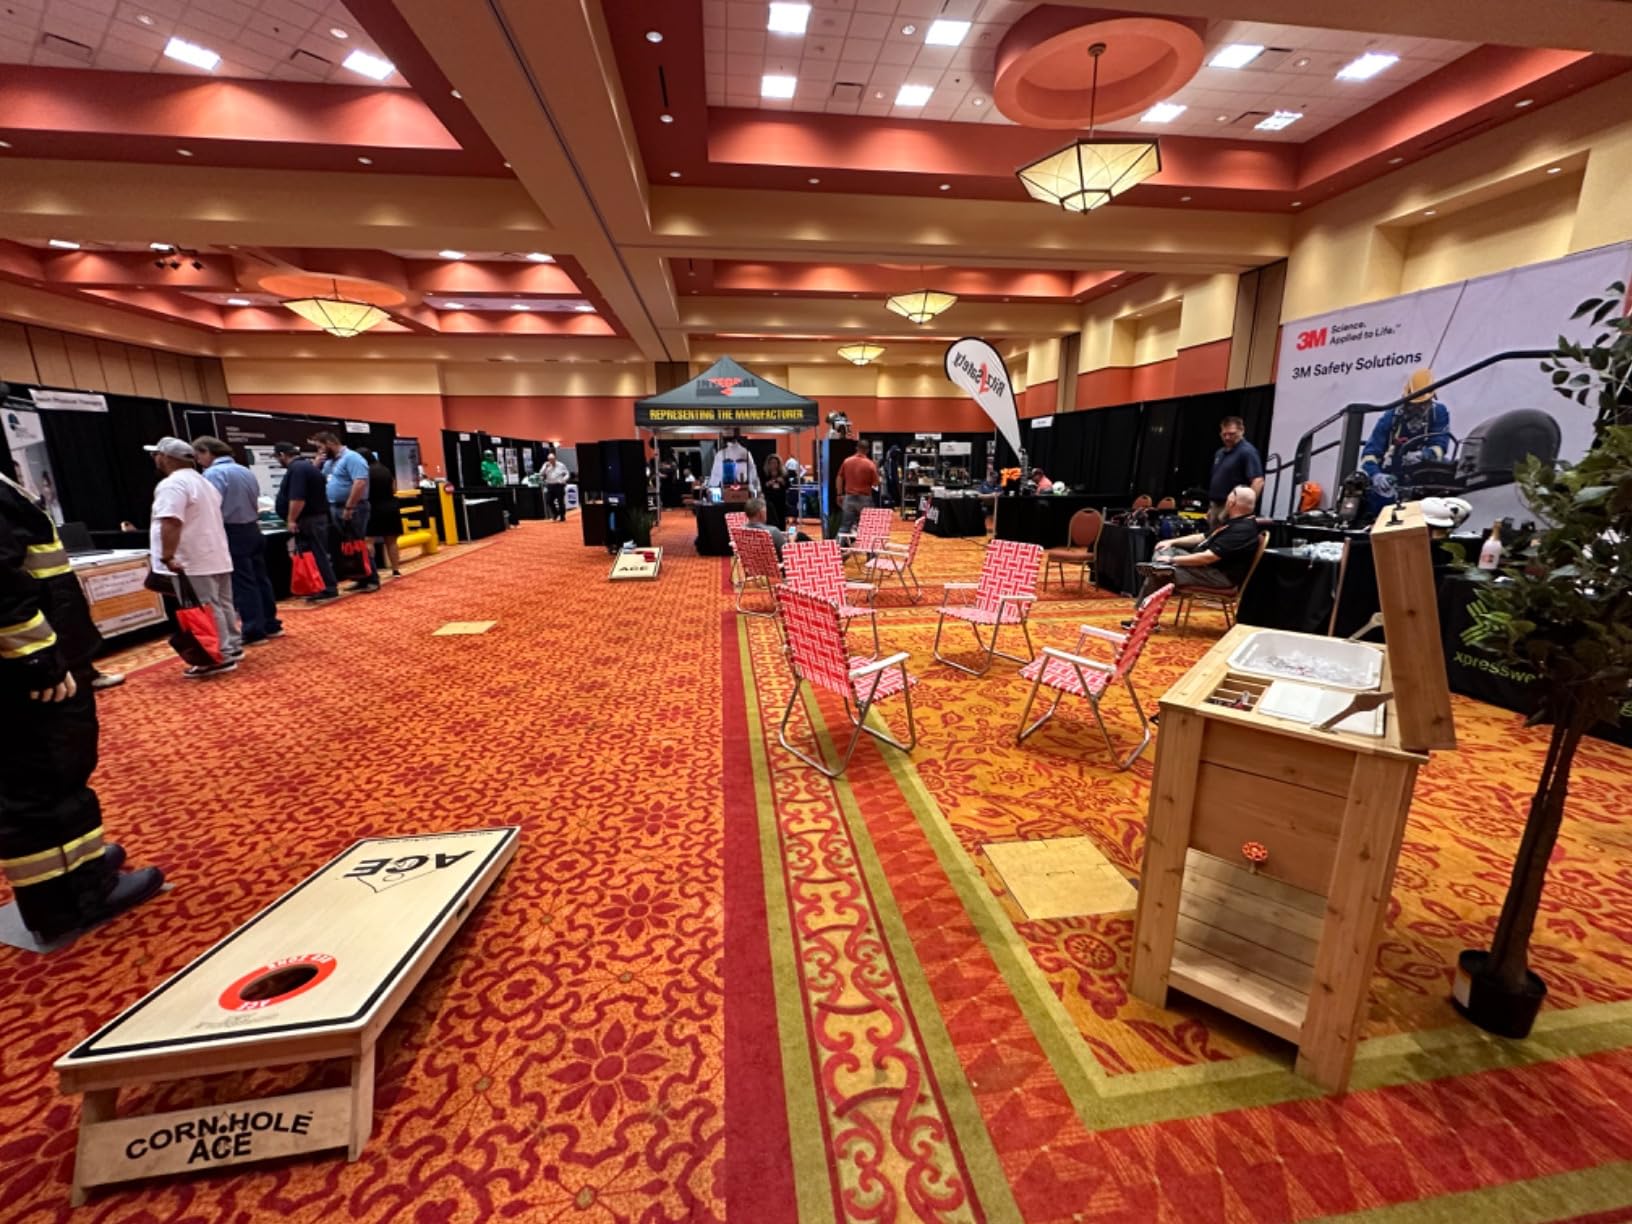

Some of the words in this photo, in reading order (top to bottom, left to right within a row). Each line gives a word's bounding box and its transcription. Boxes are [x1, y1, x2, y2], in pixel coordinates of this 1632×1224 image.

[1296, 327, 1327, 351] 3M
[1329, 332, 1362, 346] Applied
[1331, 321, 1366, 334] Science.
[1292, 366, 1311, 379] 3M
[1313, 361, 1353, 377] Safety
[1355, 352, 1422, 371] Solutions
[649, 408, 715, 421] REPRESENTING
[717, 408, 734, 420] THE
[735, 408, 804, 421] MANUFACTURER
[342, 850, 475, 878] ACE
[187, 1131, 253, 1164] ACE
